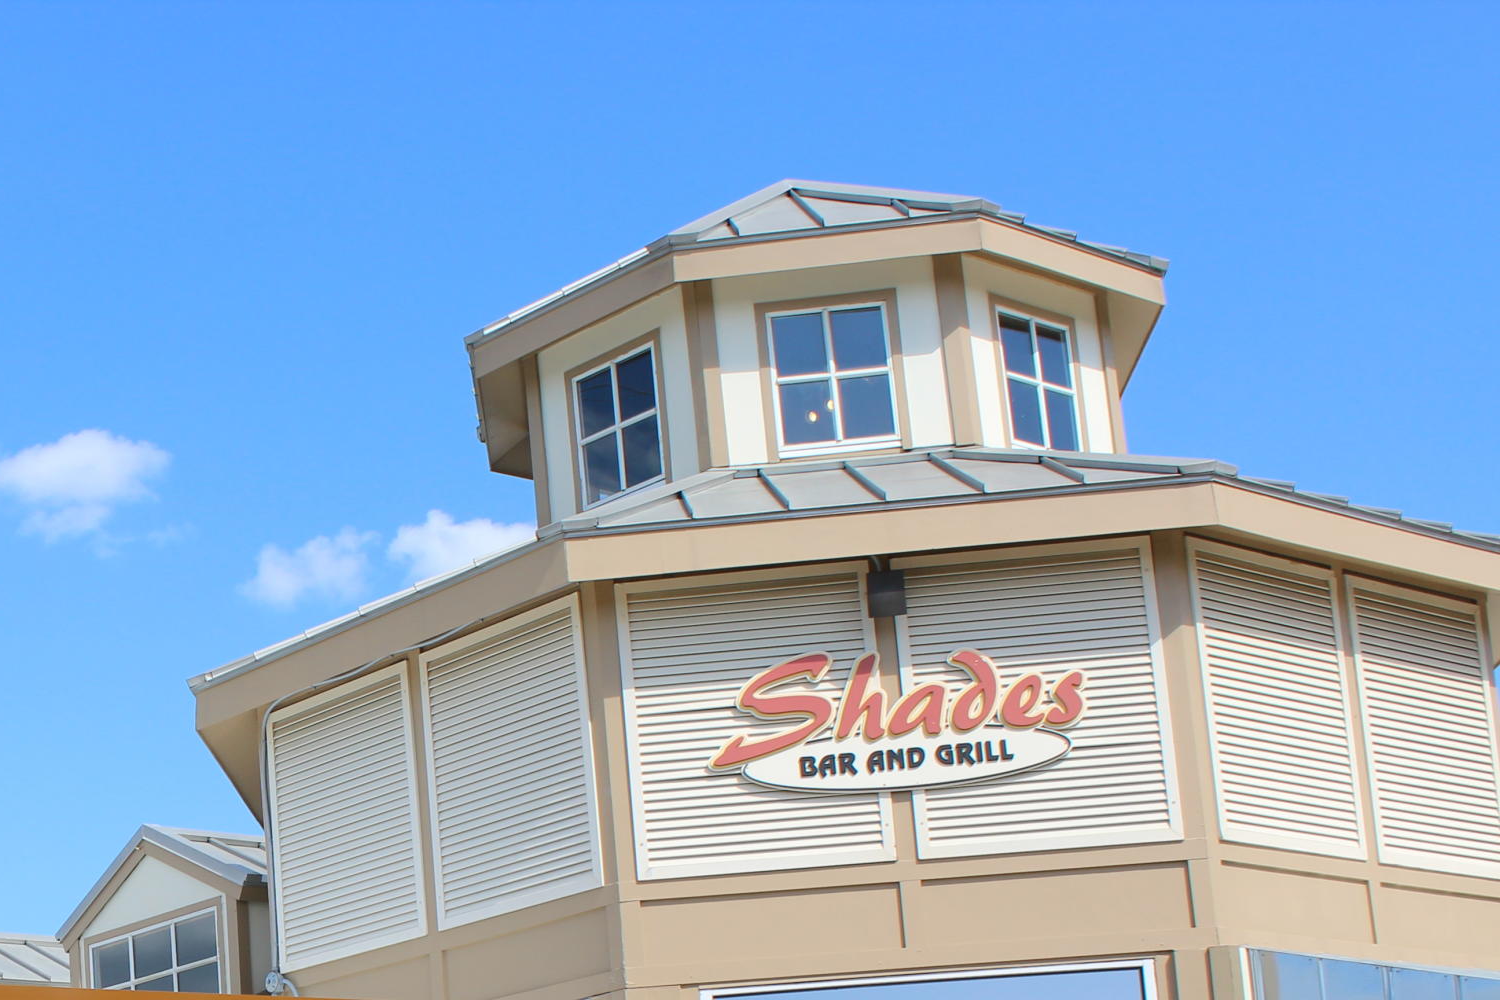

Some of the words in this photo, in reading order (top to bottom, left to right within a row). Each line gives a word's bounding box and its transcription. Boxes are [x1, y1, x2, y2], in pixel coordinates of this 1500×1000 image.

[710, 649, 1086, 769] Shades
[799, 752, 858, 778] BAR
[867, 746, 926, 774] AND
[936, 739, 1015, 769] GRILL
